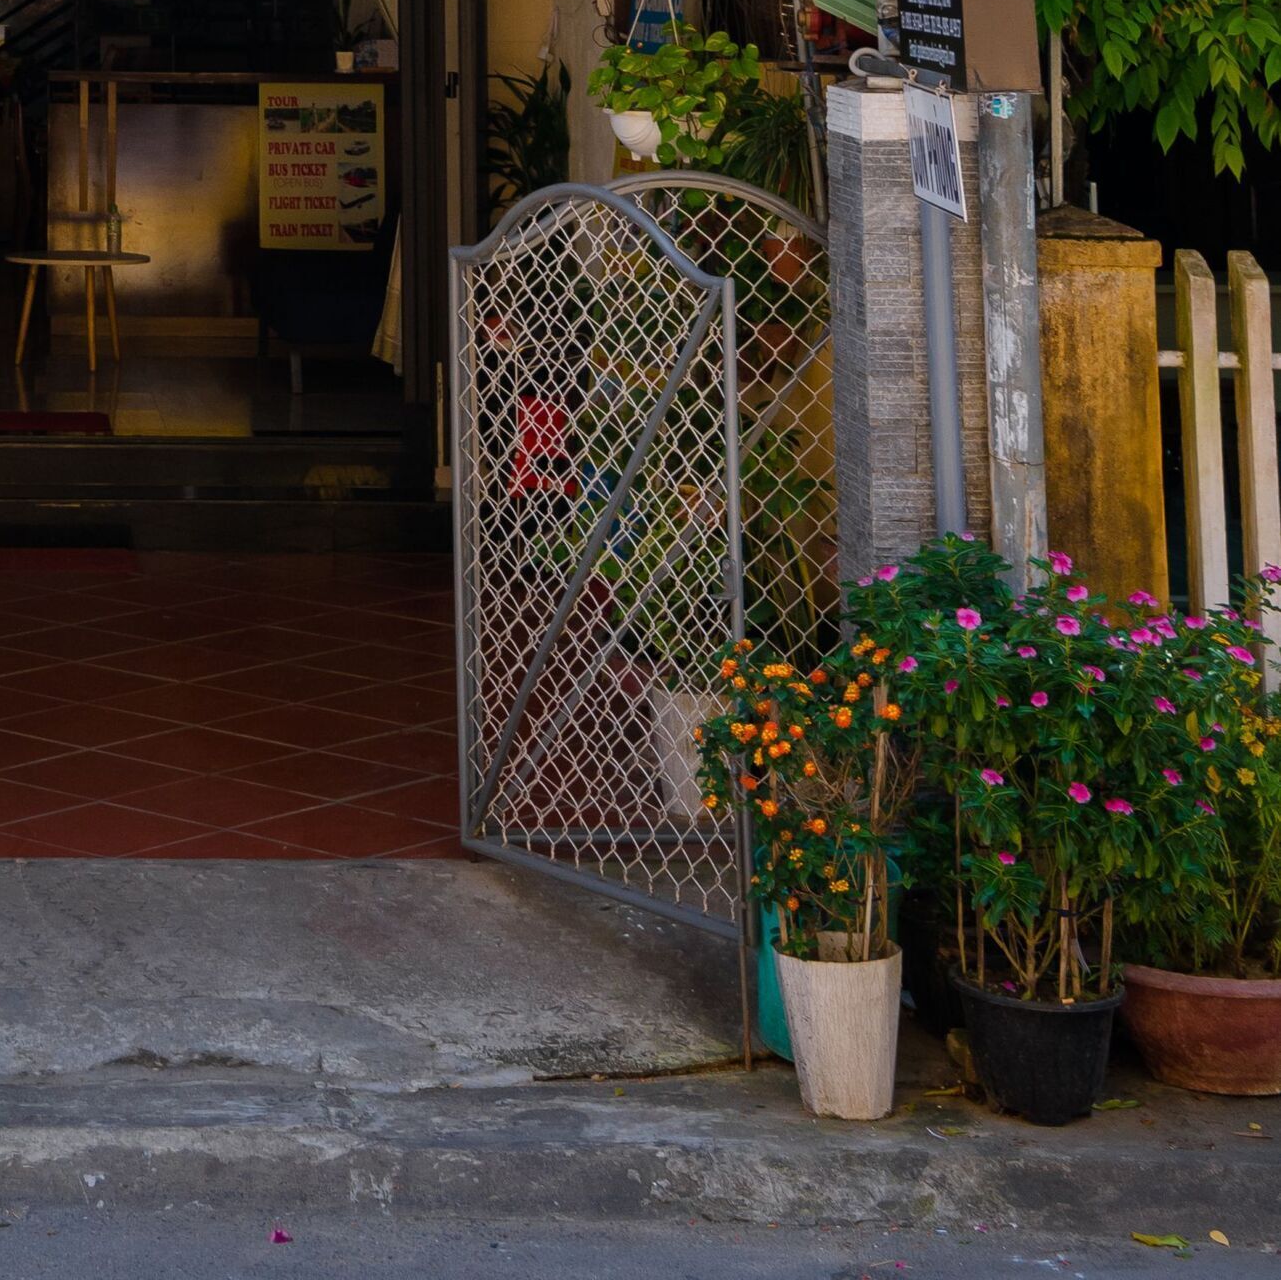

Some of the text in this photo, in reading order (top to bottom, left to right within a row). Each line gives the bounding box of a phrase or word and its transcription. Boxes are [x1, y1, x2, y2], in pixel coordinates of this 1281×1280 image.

[267, 95, 299, 107] TOUR
[268, 142, 336, 155] PRIVATE CAR
[268, 163, 327, 176] BUS TICKET
[269, 196, 337, 209] FLIGHT TICKET
[269, 224, 334, 237] TRAIN TICKET
